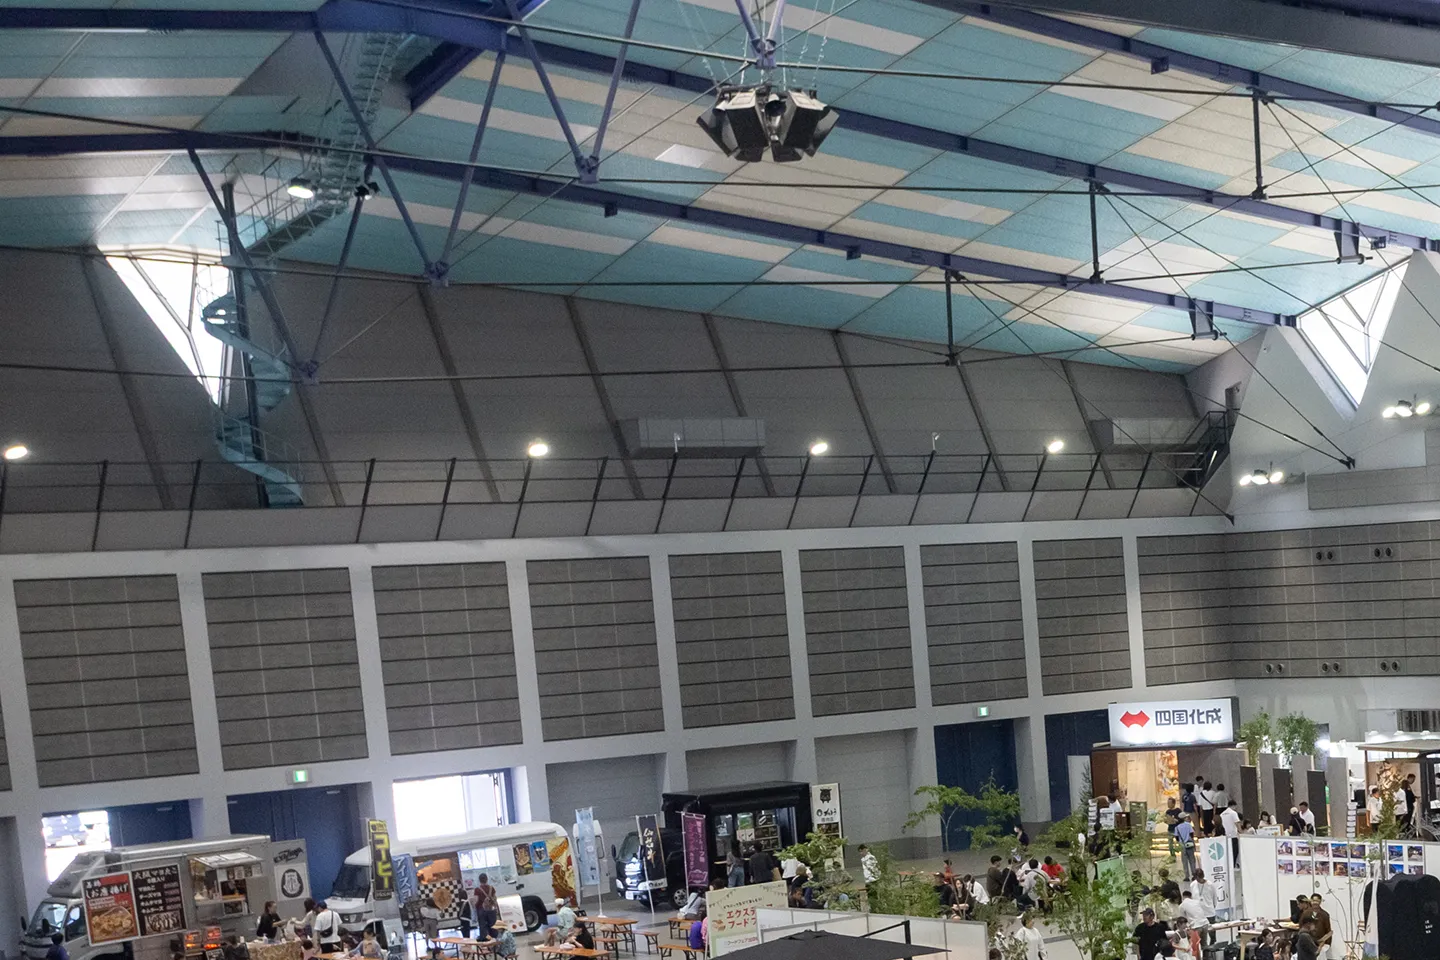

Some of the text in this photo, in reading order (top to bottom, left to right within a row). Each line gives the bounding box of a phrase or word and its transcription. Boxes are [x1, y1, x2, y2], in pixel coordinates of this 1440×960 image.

[1154, 708, 1222, 726] 四国化成
[374, 833, 393, 889] コーヒー
